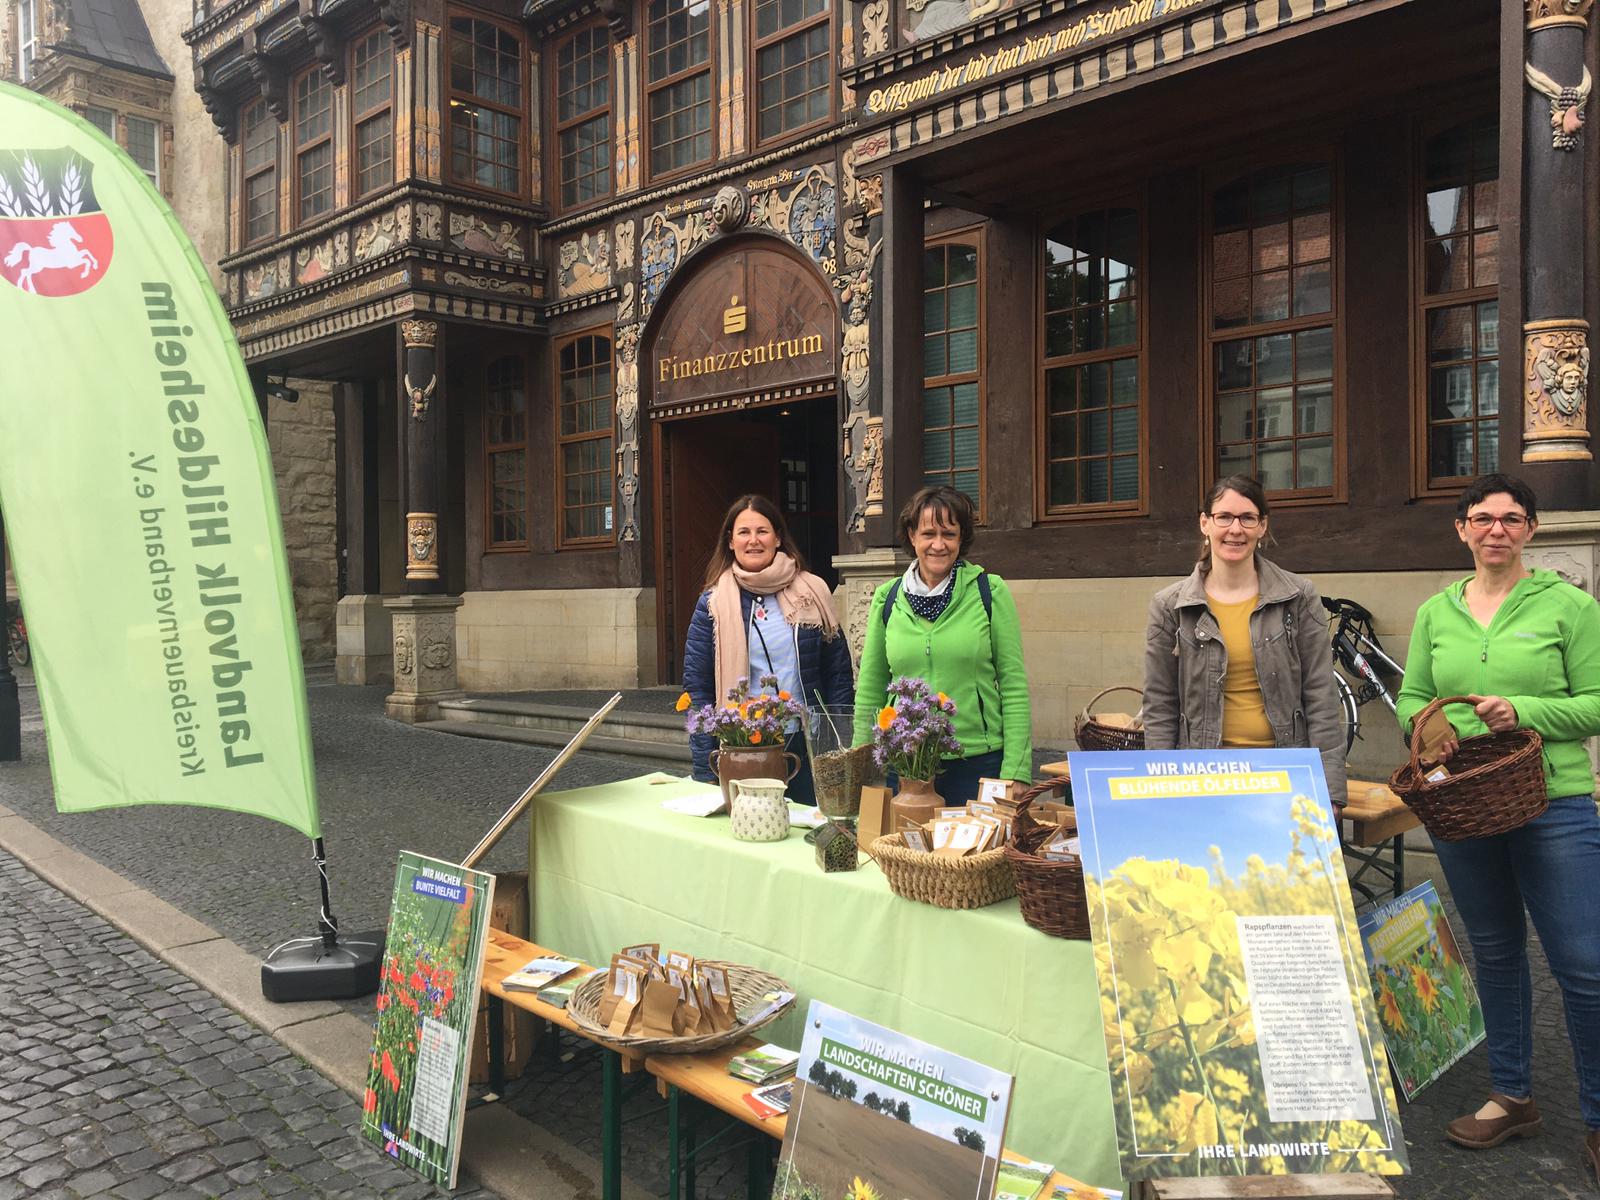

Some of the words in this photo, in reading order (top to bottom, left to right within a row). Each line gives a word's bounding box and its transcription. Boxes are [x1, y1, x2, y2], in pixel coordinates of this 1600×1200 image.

[659, 333, 823, 383] Finanzzentrum
[1146, 762, 1178, 776] WIR
[1183, 761, 1251, 775] MACHEN
[1119, 777, 1200, 795] BLÜHENDE
[1203, 776, 1280, 792] ÖLFELDER
[423, 867, 434, 880] WIR
[434, 870, 461, 887] MACHEN
[434, 885, 461, 900] VIELFALT
[857, 1034, 888, 1058] WIR
[886, 1047, 945, 1080] MACHEN
[823, 1043, 917, 1091] LANDSCHAFTEN
[918, 1080, 982, 1117] SCHÖNER
[1199, 1145, 1235, 1158] IHRE
[1240, 1142, 1331, 1157] LANDWIRTE
